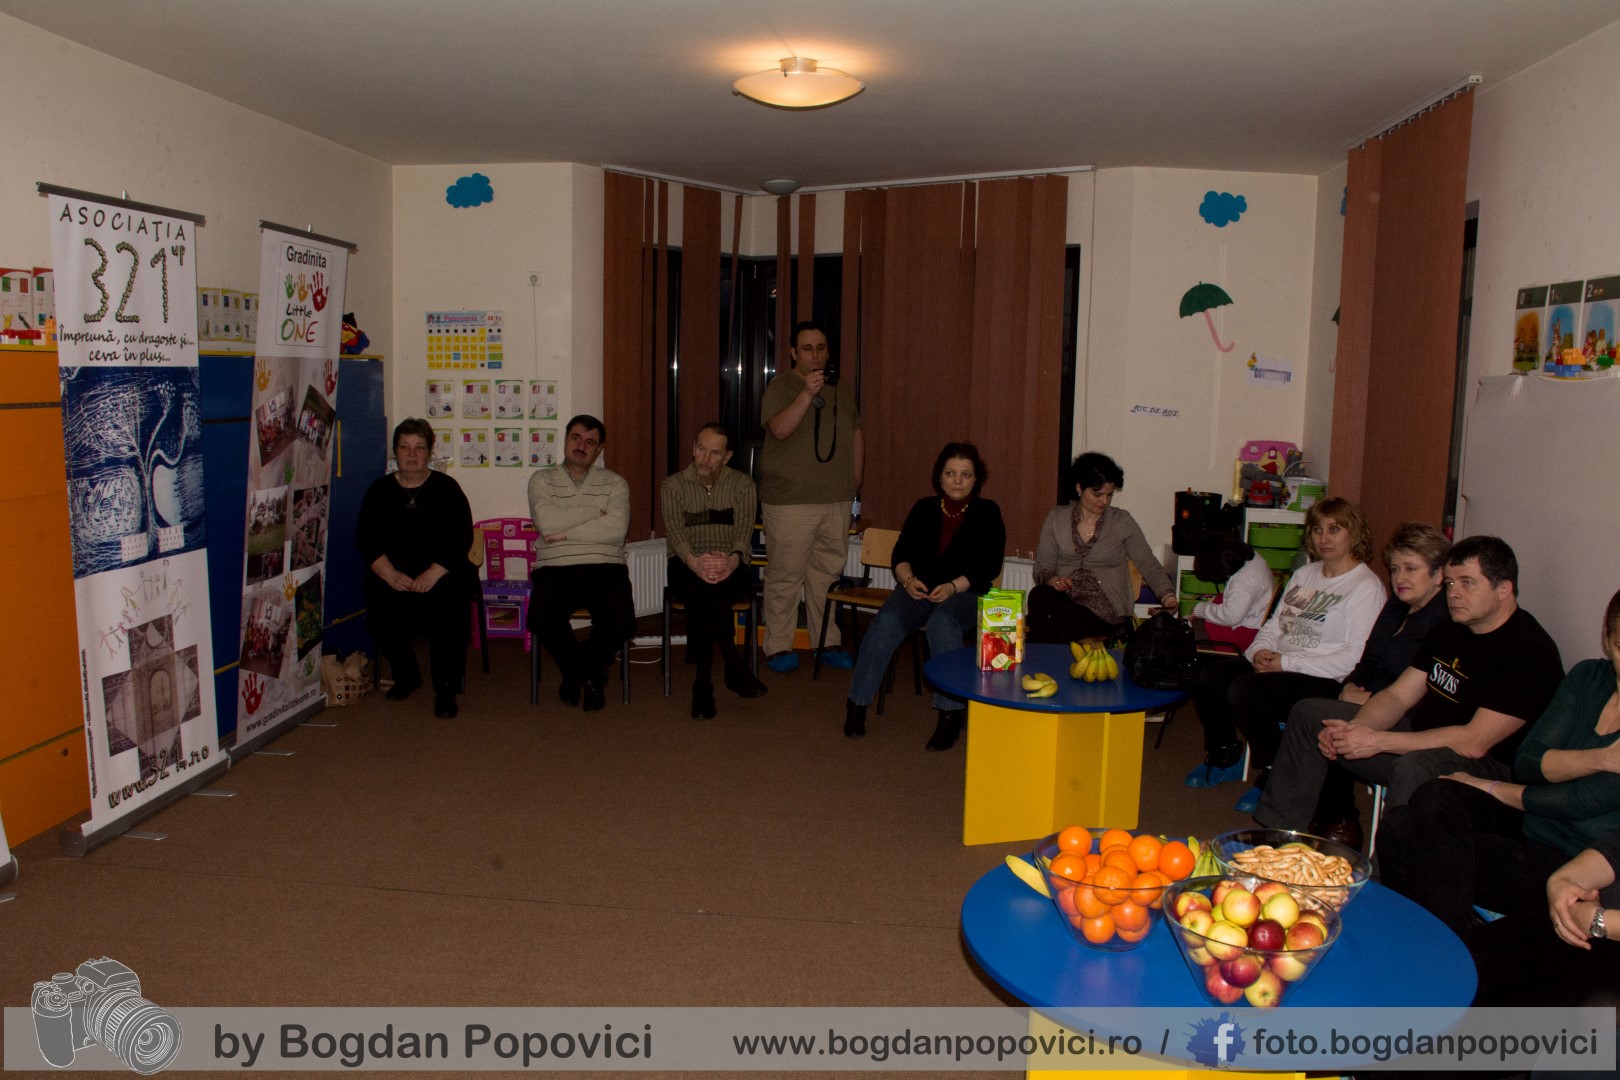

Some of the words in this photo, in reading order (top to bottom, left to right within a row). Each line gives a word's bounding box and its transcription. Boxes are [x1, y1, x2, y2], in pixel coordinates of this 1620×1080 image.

[286, 245, 327, 269] Gradinita
[286, 303, 313, 318] Little
[281, 317, 319, 343] ONE
[124, 335, 138, 343] cu
[139, 331, 178, 348] dragoste
[89, 350, 123, 362] ceva
